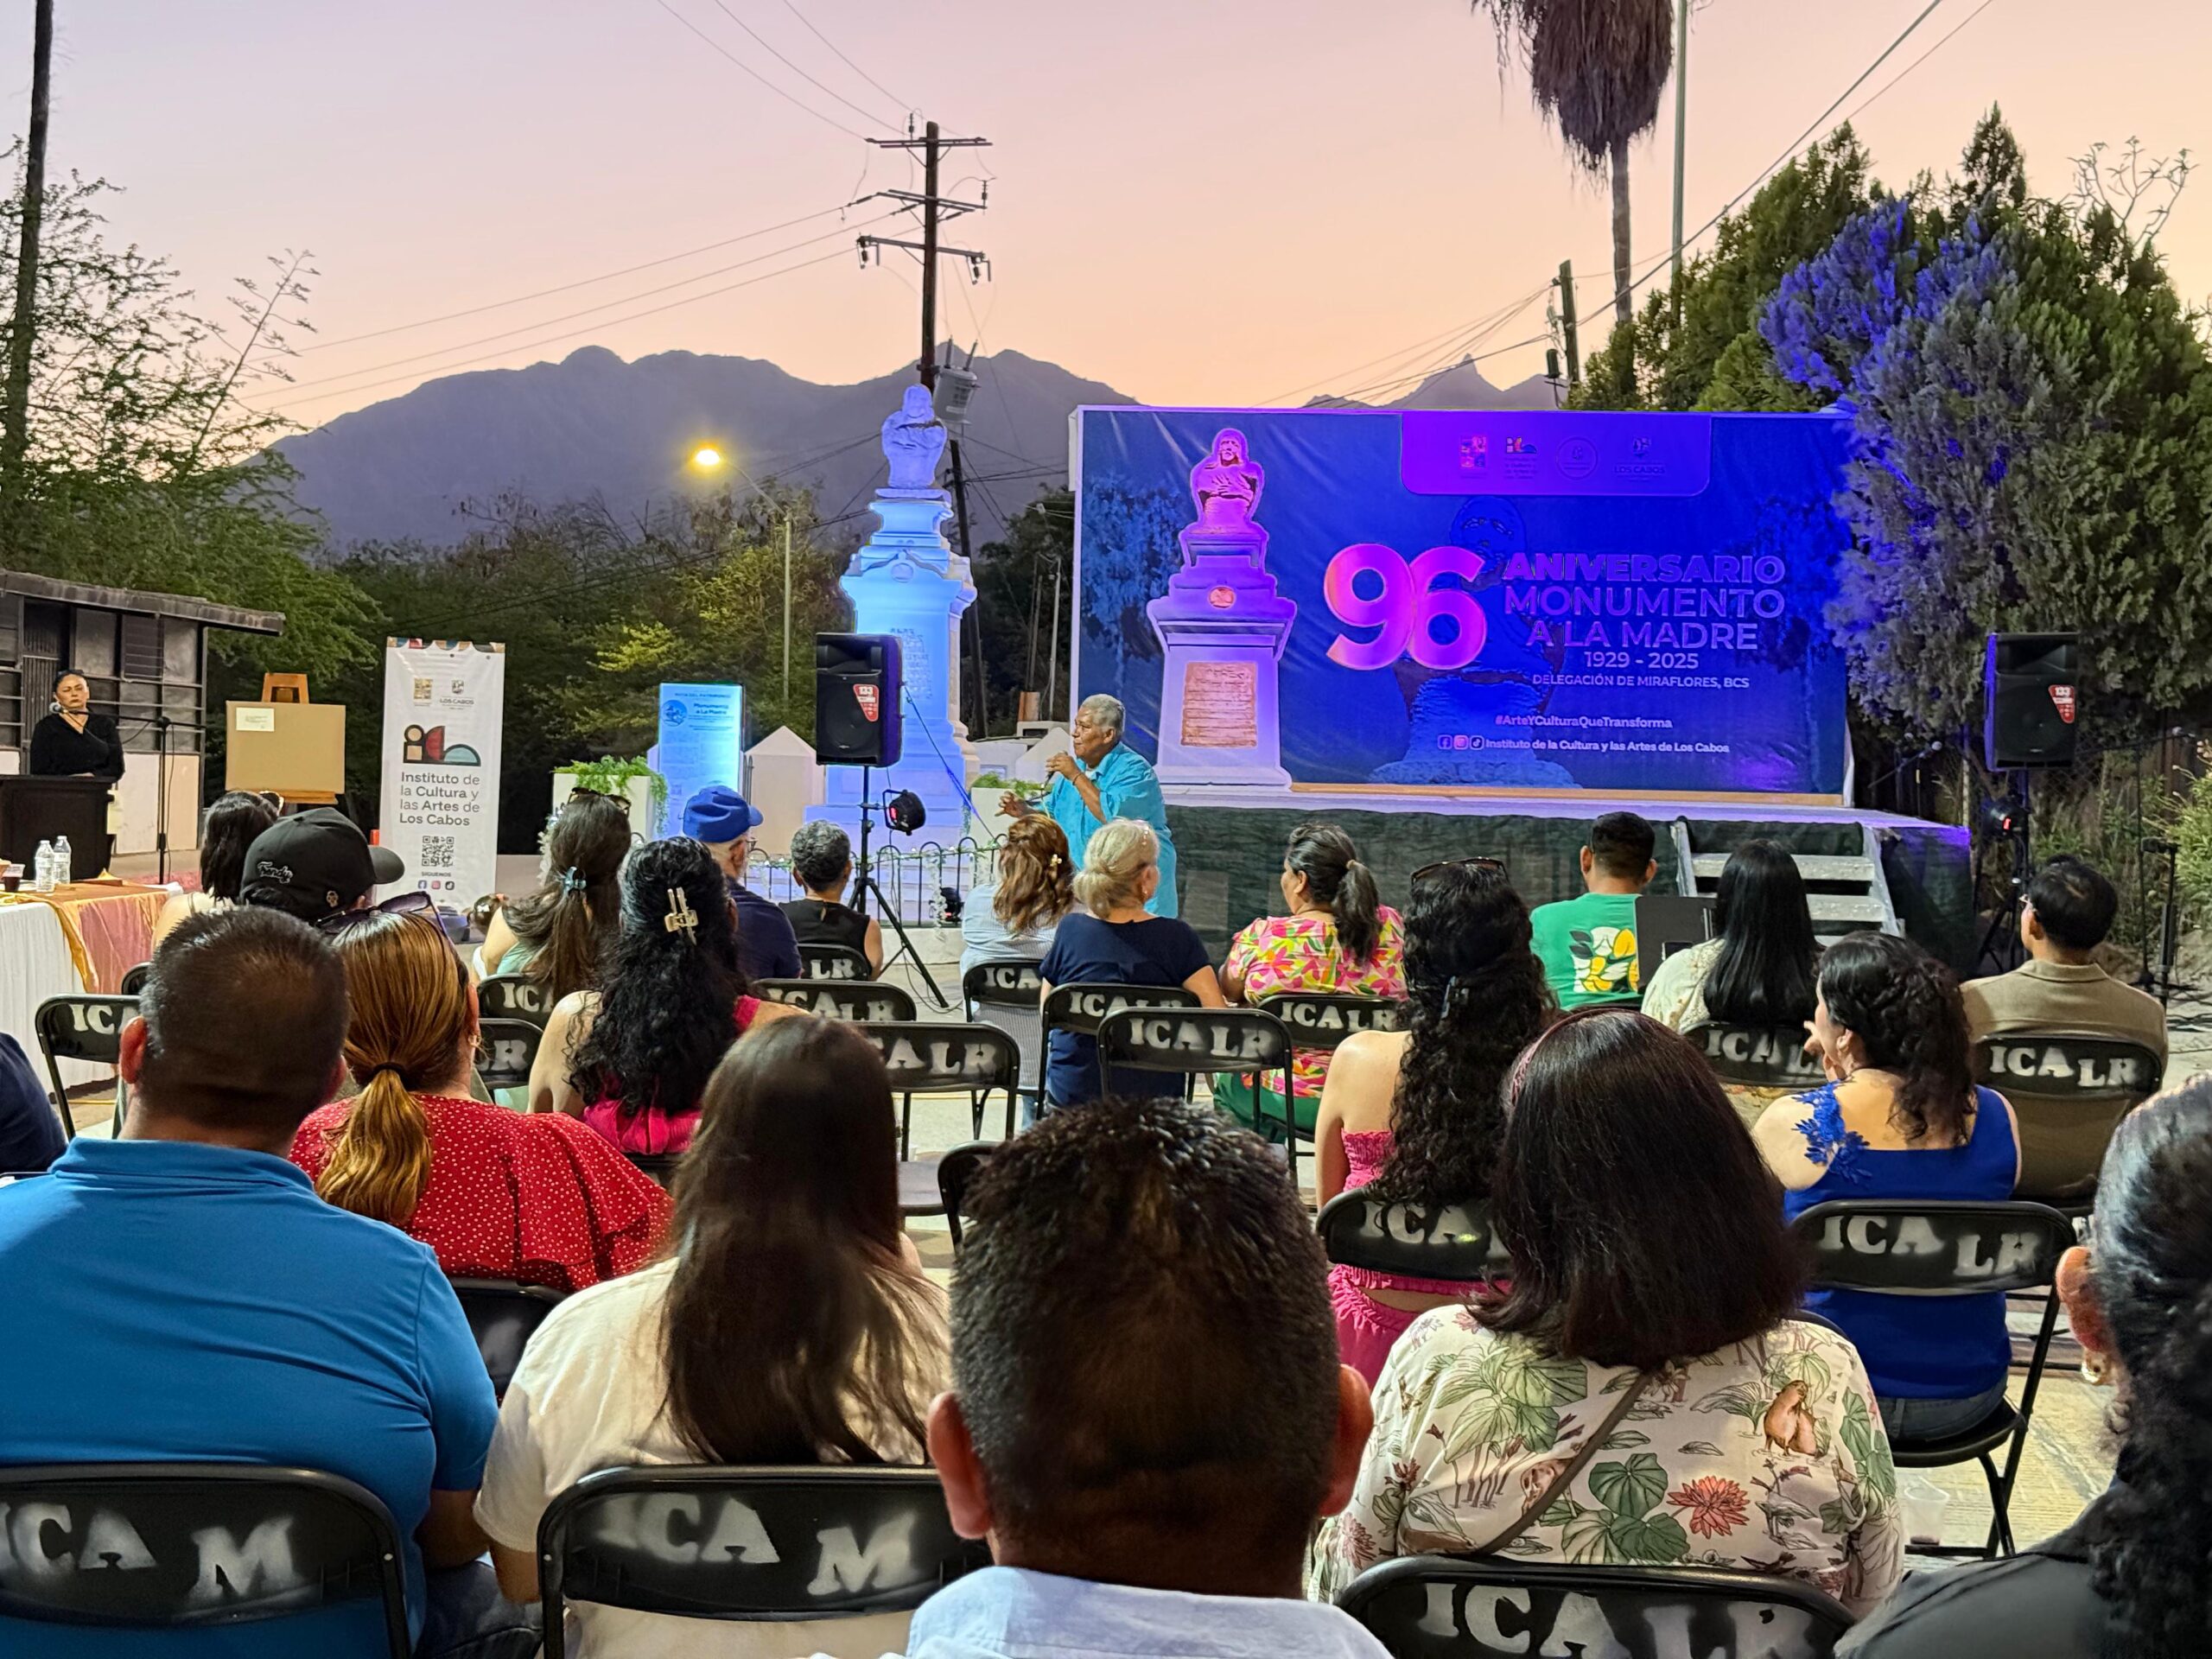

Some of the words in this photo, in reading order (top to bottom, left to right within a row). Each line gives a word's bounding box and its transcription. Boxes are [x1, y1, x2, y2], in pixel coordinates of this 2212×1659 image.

[1503, 552, 1786, 583] ANIVERSARIO
[1324, 543, 1487, 671] 96
[1504, 586, 1785, 618] MONUMENTO
[1526, 620, 1554, 646] A
[1565, 621, 1611, 648] LA
[1623, 623, 1758, 650] MADRE
[1586, 652, 1630, 668] 1929
[1648, 653, 1699, 669] 2025
[1533, 672, 1615, 686] DELEGACIÓN
[1618, 675, 1635, 686] DE
[1637, 676, 1720, 689] MIRAFLORES,
[1724, 677, 1749, 689] BCS
[1495, 715, 1673, 728] #ArteYCulturaQueTransforma
[1485, 739, 1531, 749] Instituto
[1532, 739, 1547, 749] de
[1548, 740, 1558, 749] la
[1560, 741, 1599, 750] Cultura
[1601, 743, 1608, 753] y
[1610, 741, 1625, 751] las
[1627, 741, 1656, 752] Artes
[1658, 741, 1673, 752] de
[1675, 742, 1694, 752] Los
[1695, 742, 1730, 753] Cabos
[401, 772, 459, 784] Instituto
[463, 774, 480, 785] de
[400, 785, 411, 796] la
[416, 786, 467, 798] Cultura
[471, 790, 479, 801] y
[400, 799, 418, 810] las
[422, 800, 459, 811] Artes
[463, 802, 480, 812] de
[399, 813, 423, 824] Los
[426, 814, 470, 826] Cabos
